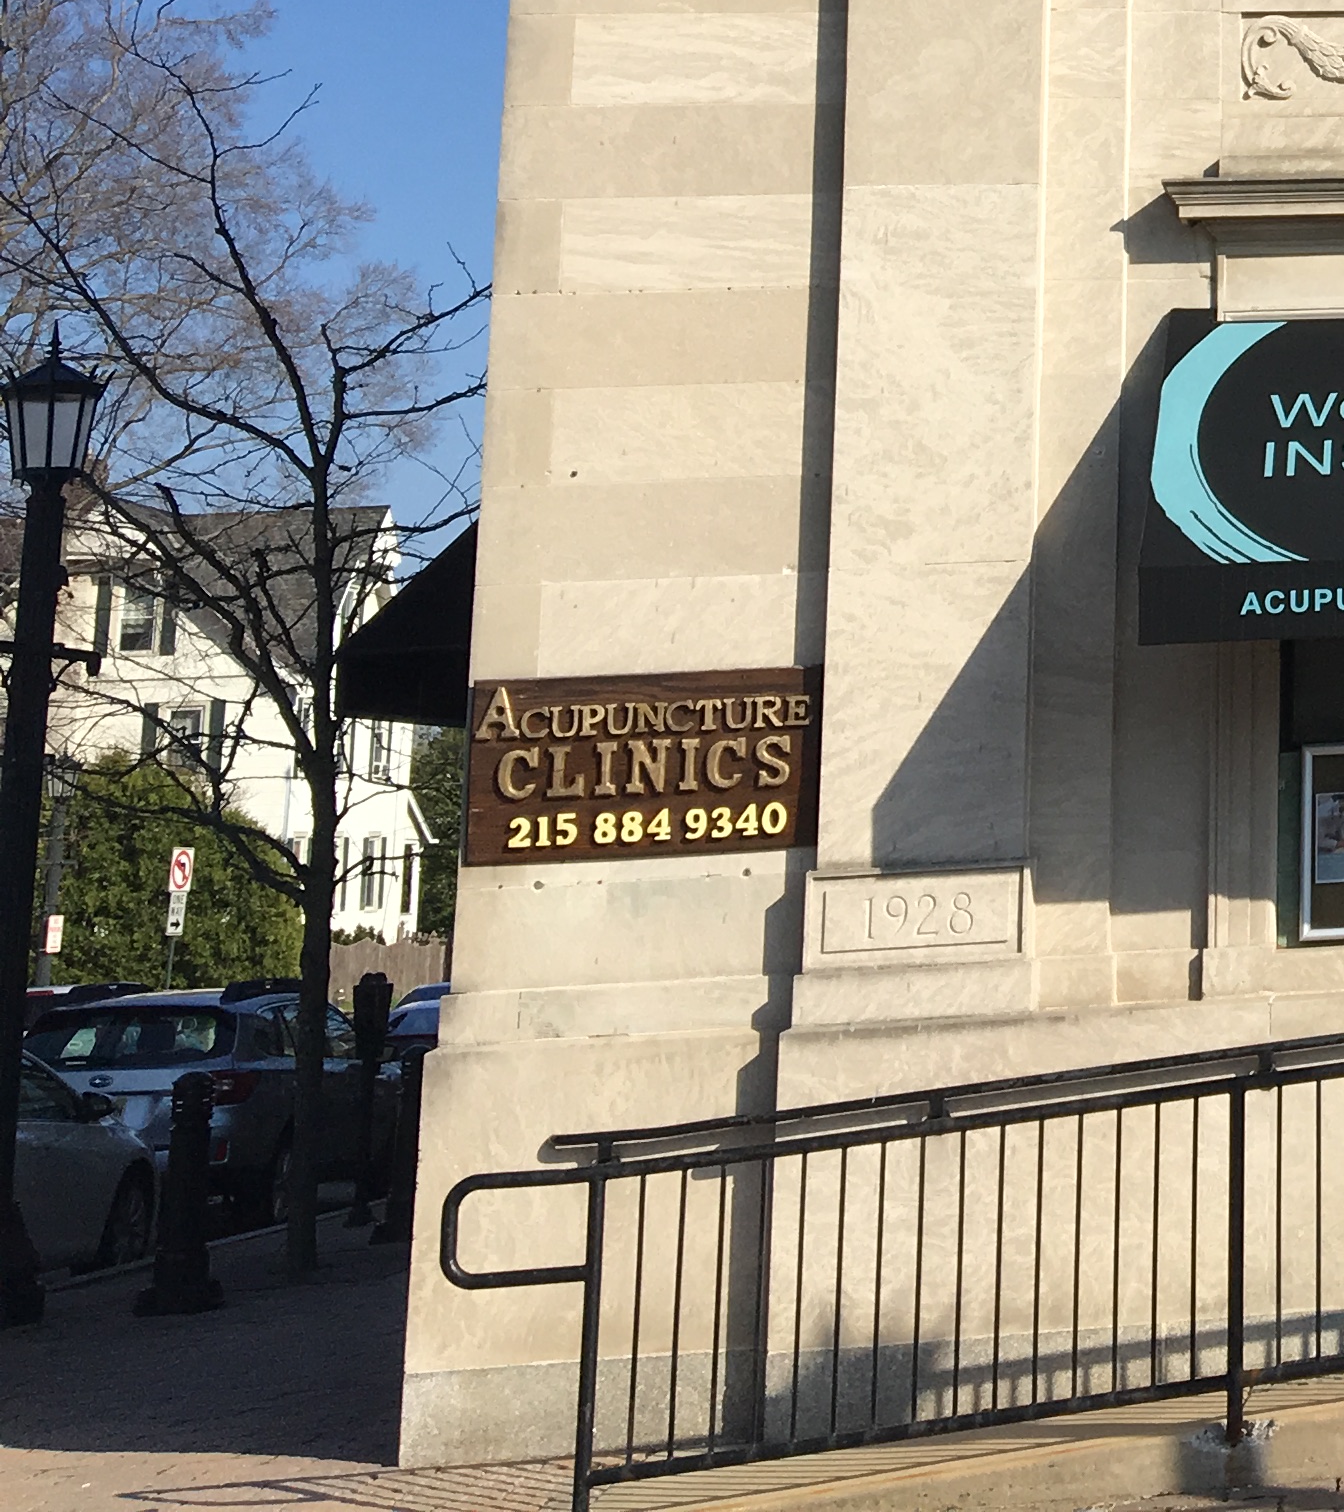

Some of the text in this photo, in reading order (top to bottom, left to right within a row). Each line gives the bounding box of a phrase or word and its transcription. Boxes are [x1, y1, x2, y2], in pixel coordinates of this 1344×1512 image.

[475, 685, 812, 741] ACUPUNCTURE
[496, 734, 793, 801] CLINICS
[507, 801, 788, 849] 215 884 9340
[862, 890, 976, 941] 1928
